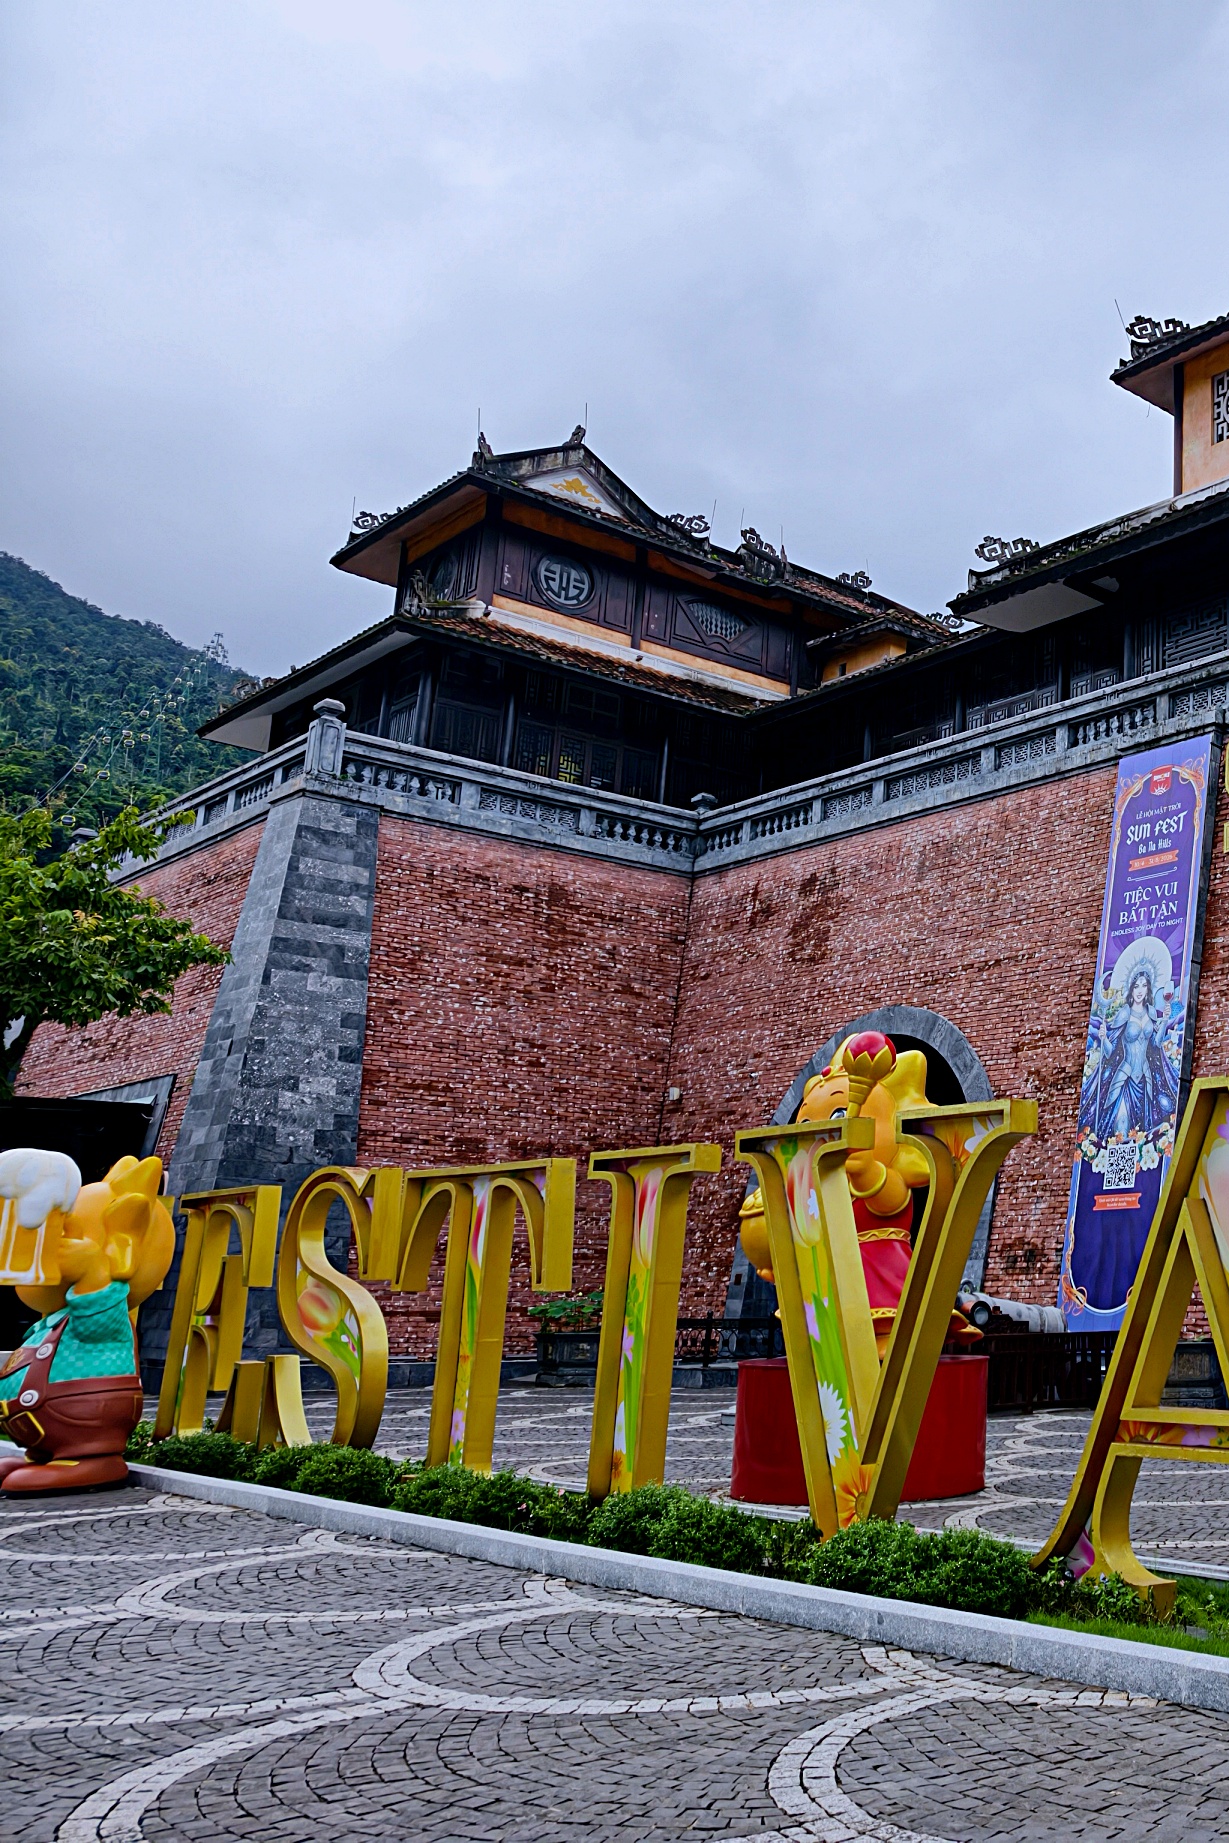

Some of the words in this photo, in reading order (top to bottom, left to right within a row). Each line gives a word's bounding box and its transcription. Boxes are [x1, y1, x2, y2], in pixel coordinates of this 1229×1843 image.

[1123, 886, 1152, 905] TIỆC
[1154, 882, 1178, 898] VUI
[1118, 905, 1147, 925] BẤT
[1150, 900, 1179, 919] TẬN
[1111, 928, 1135, 937] ENDLESS
[1166, 918, 1183, 927] NIGHT
